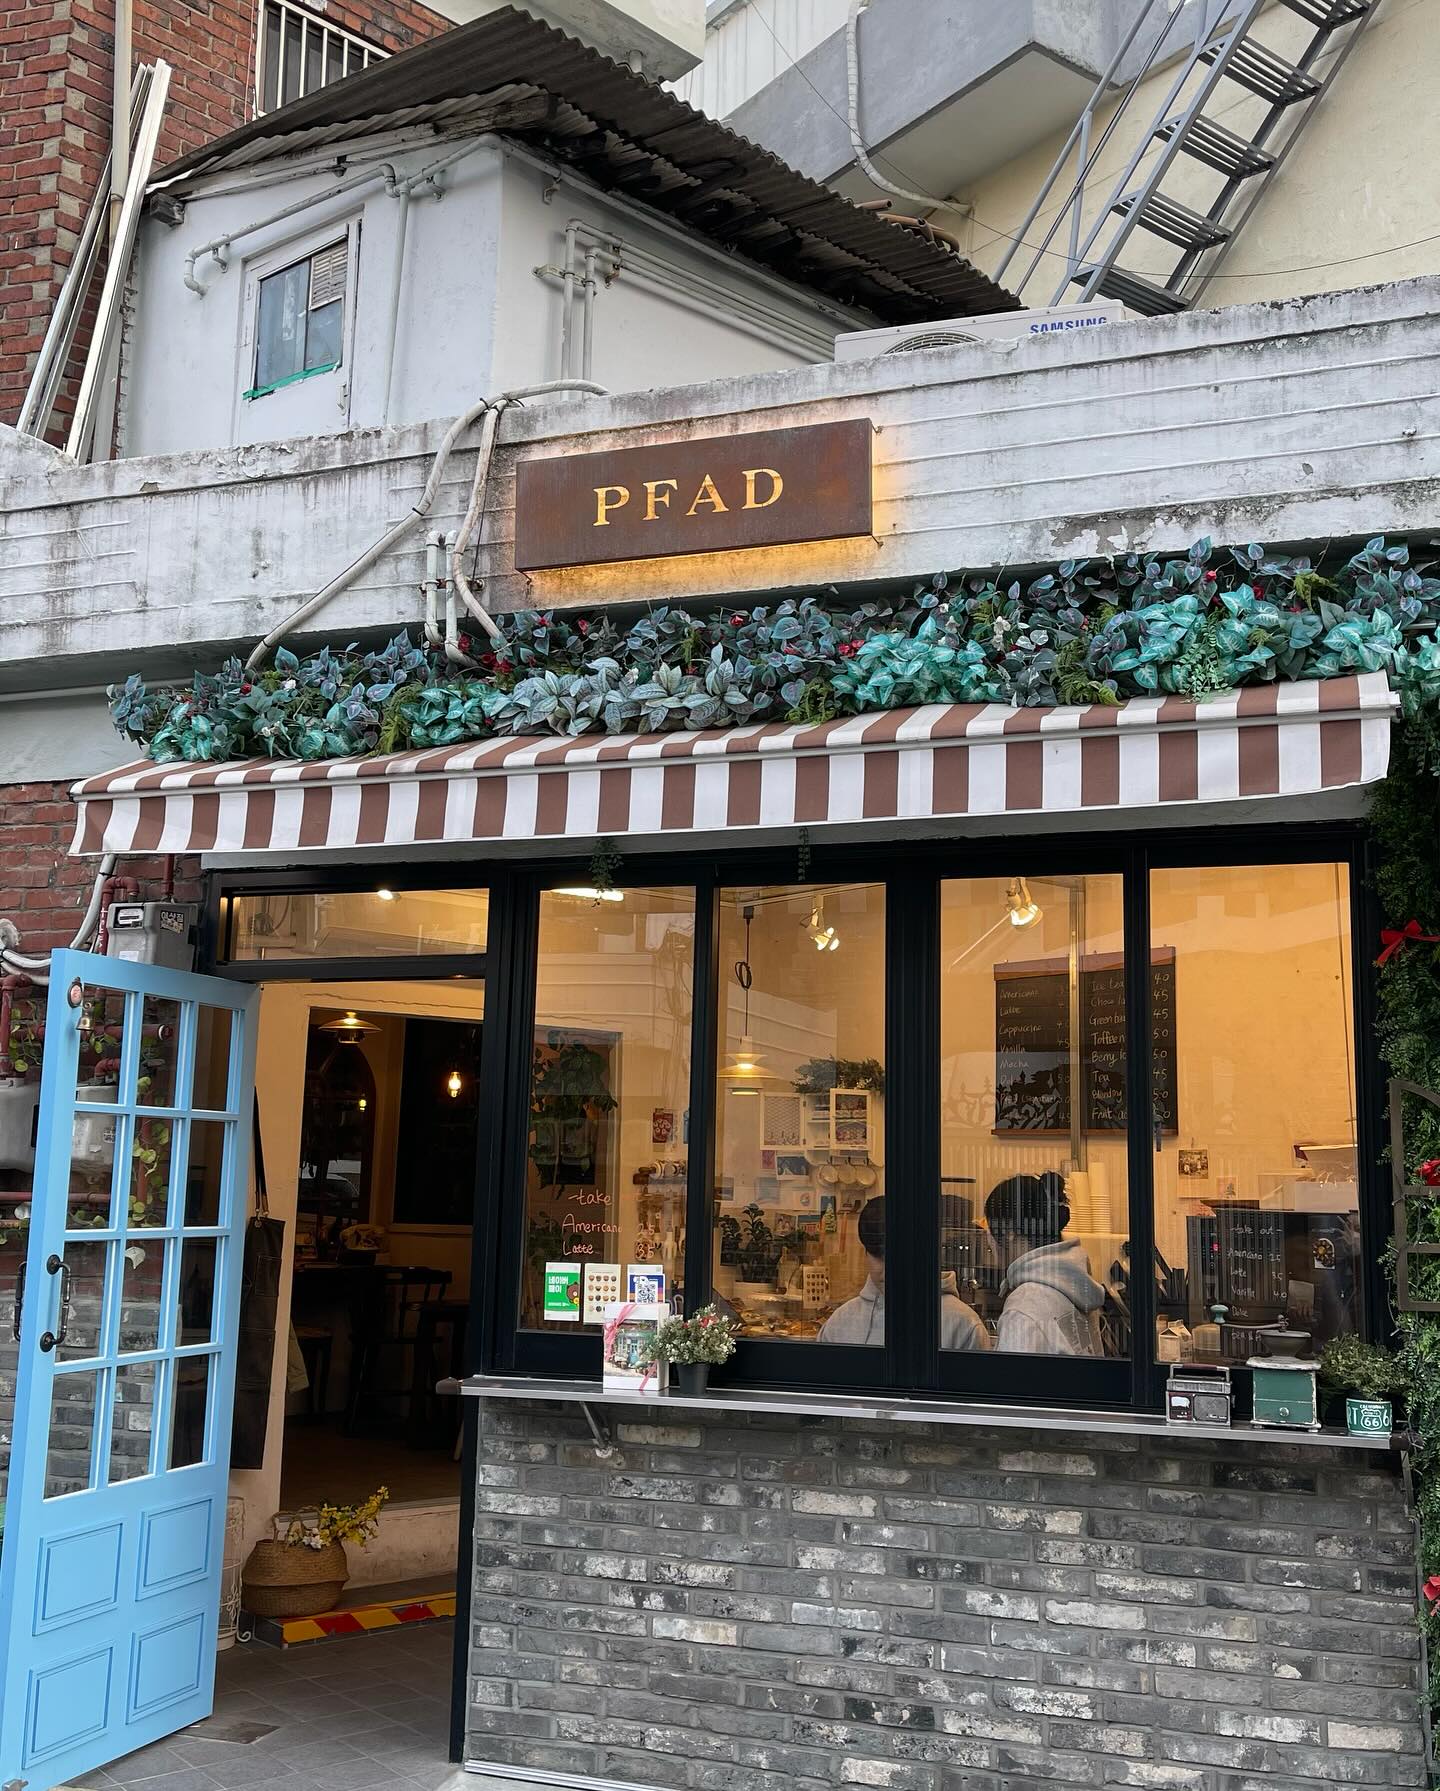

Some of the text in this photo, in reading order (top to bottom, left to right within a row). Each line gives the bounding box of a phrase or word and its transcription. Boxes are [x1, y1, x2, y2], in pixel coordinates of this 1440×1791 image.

[1030, 317, 1107, 334] SAMSUNG
[593, 468, 784, 527] PFAD
[562, 1213, 622, 1234] Americano
[562, 1241, 594, 1256] Latte
[1363, 1417, 1380, 1428] 66
